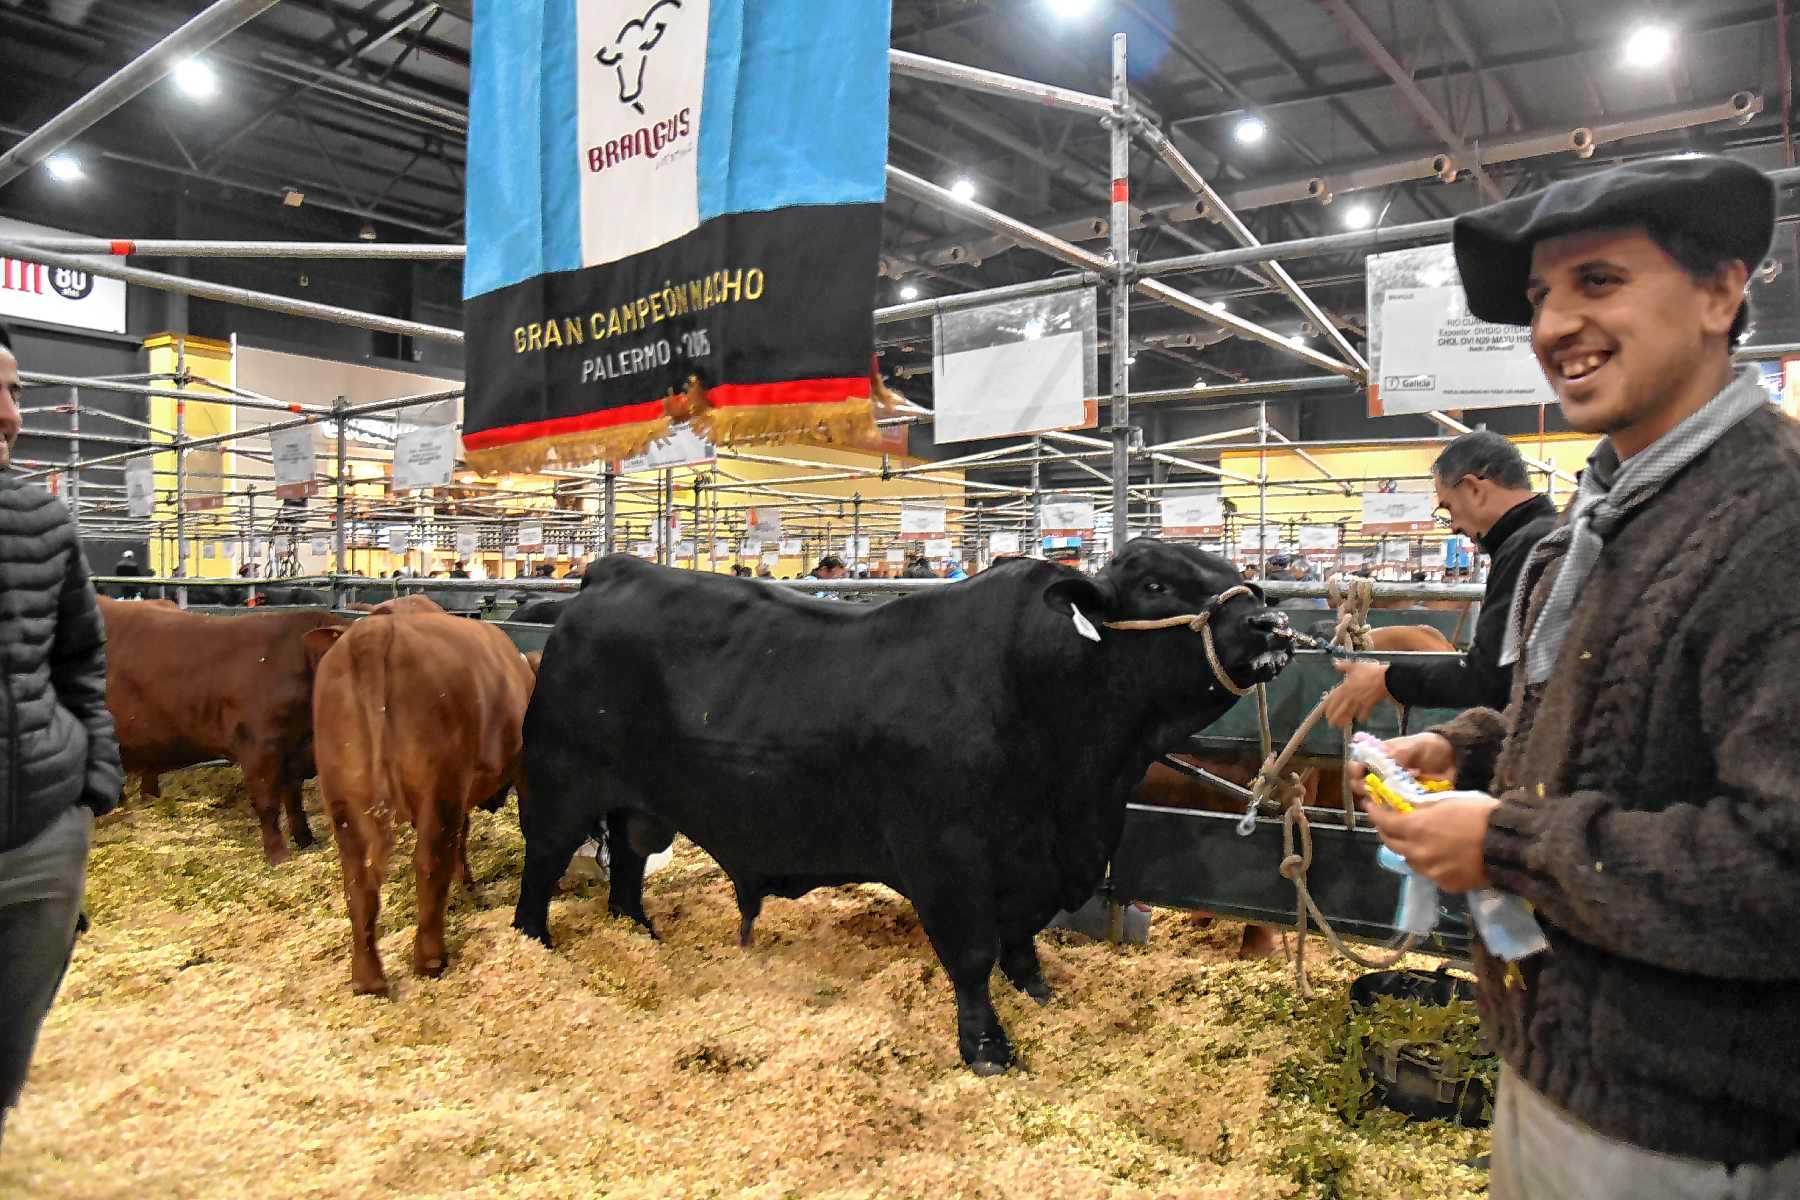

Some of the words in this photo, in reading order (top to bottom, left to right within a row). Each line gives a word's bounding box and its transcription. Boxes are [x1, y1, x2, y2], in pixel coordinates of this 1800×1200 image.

[588, 107, 690, 172] BRANGUS
[514, 316, 584, 353] GRAN
[590, 280, 688, 340] CAMPEÓN
[581, 339, 671, 384] PALERMO
[1402, 379, 1431, 389] Galicia
